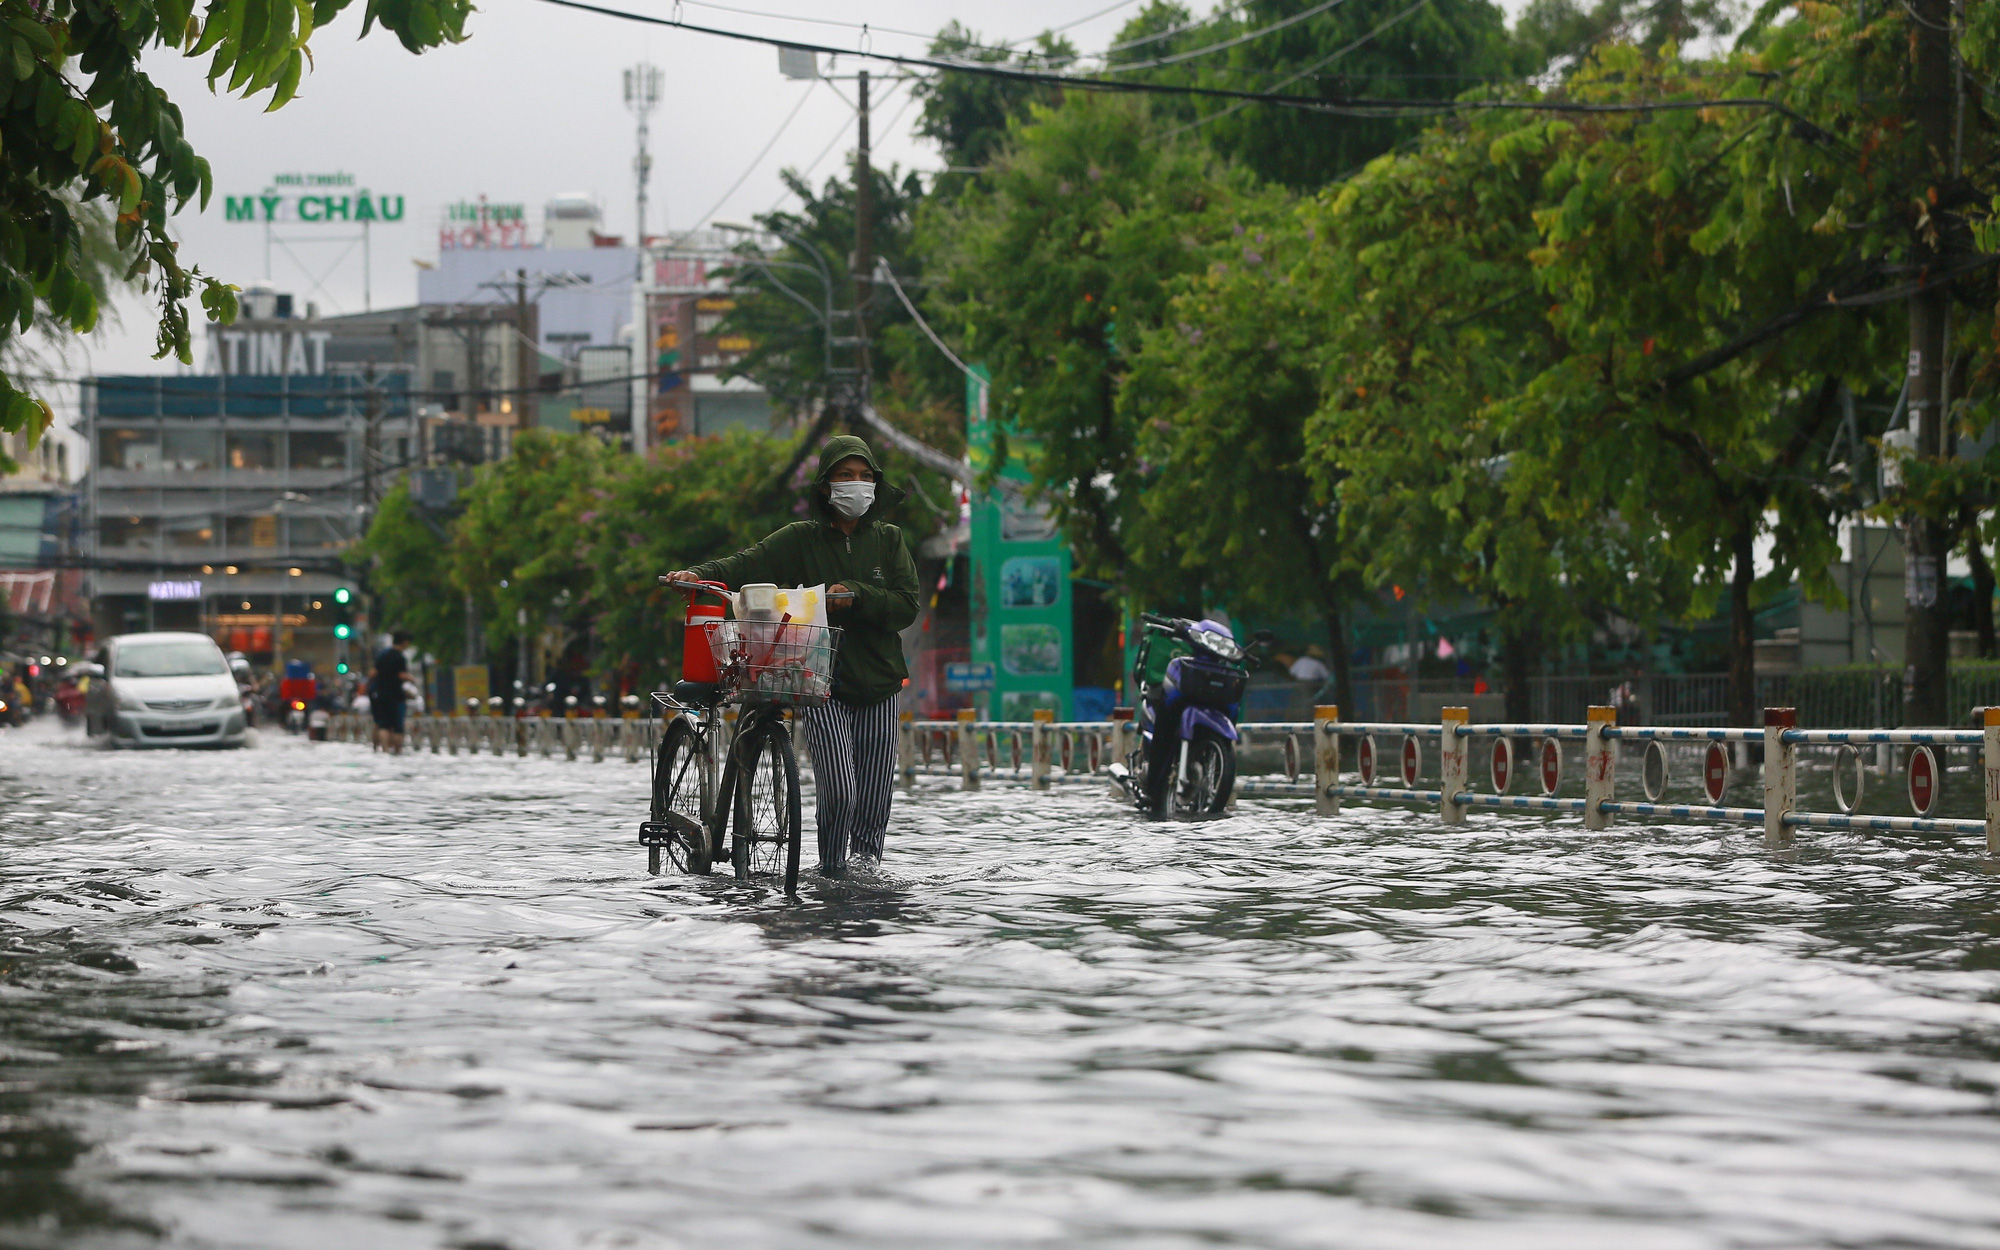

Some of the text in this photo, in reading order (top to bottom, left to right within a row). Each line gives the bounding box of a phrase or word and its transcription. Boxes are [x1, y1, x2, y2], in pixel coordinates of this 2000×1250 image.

[225, 187, 404, 222] MỸ CHÂU
[440, 224, 533, 249] HOTEL
[184, 331, 332, 376] ATINAT
